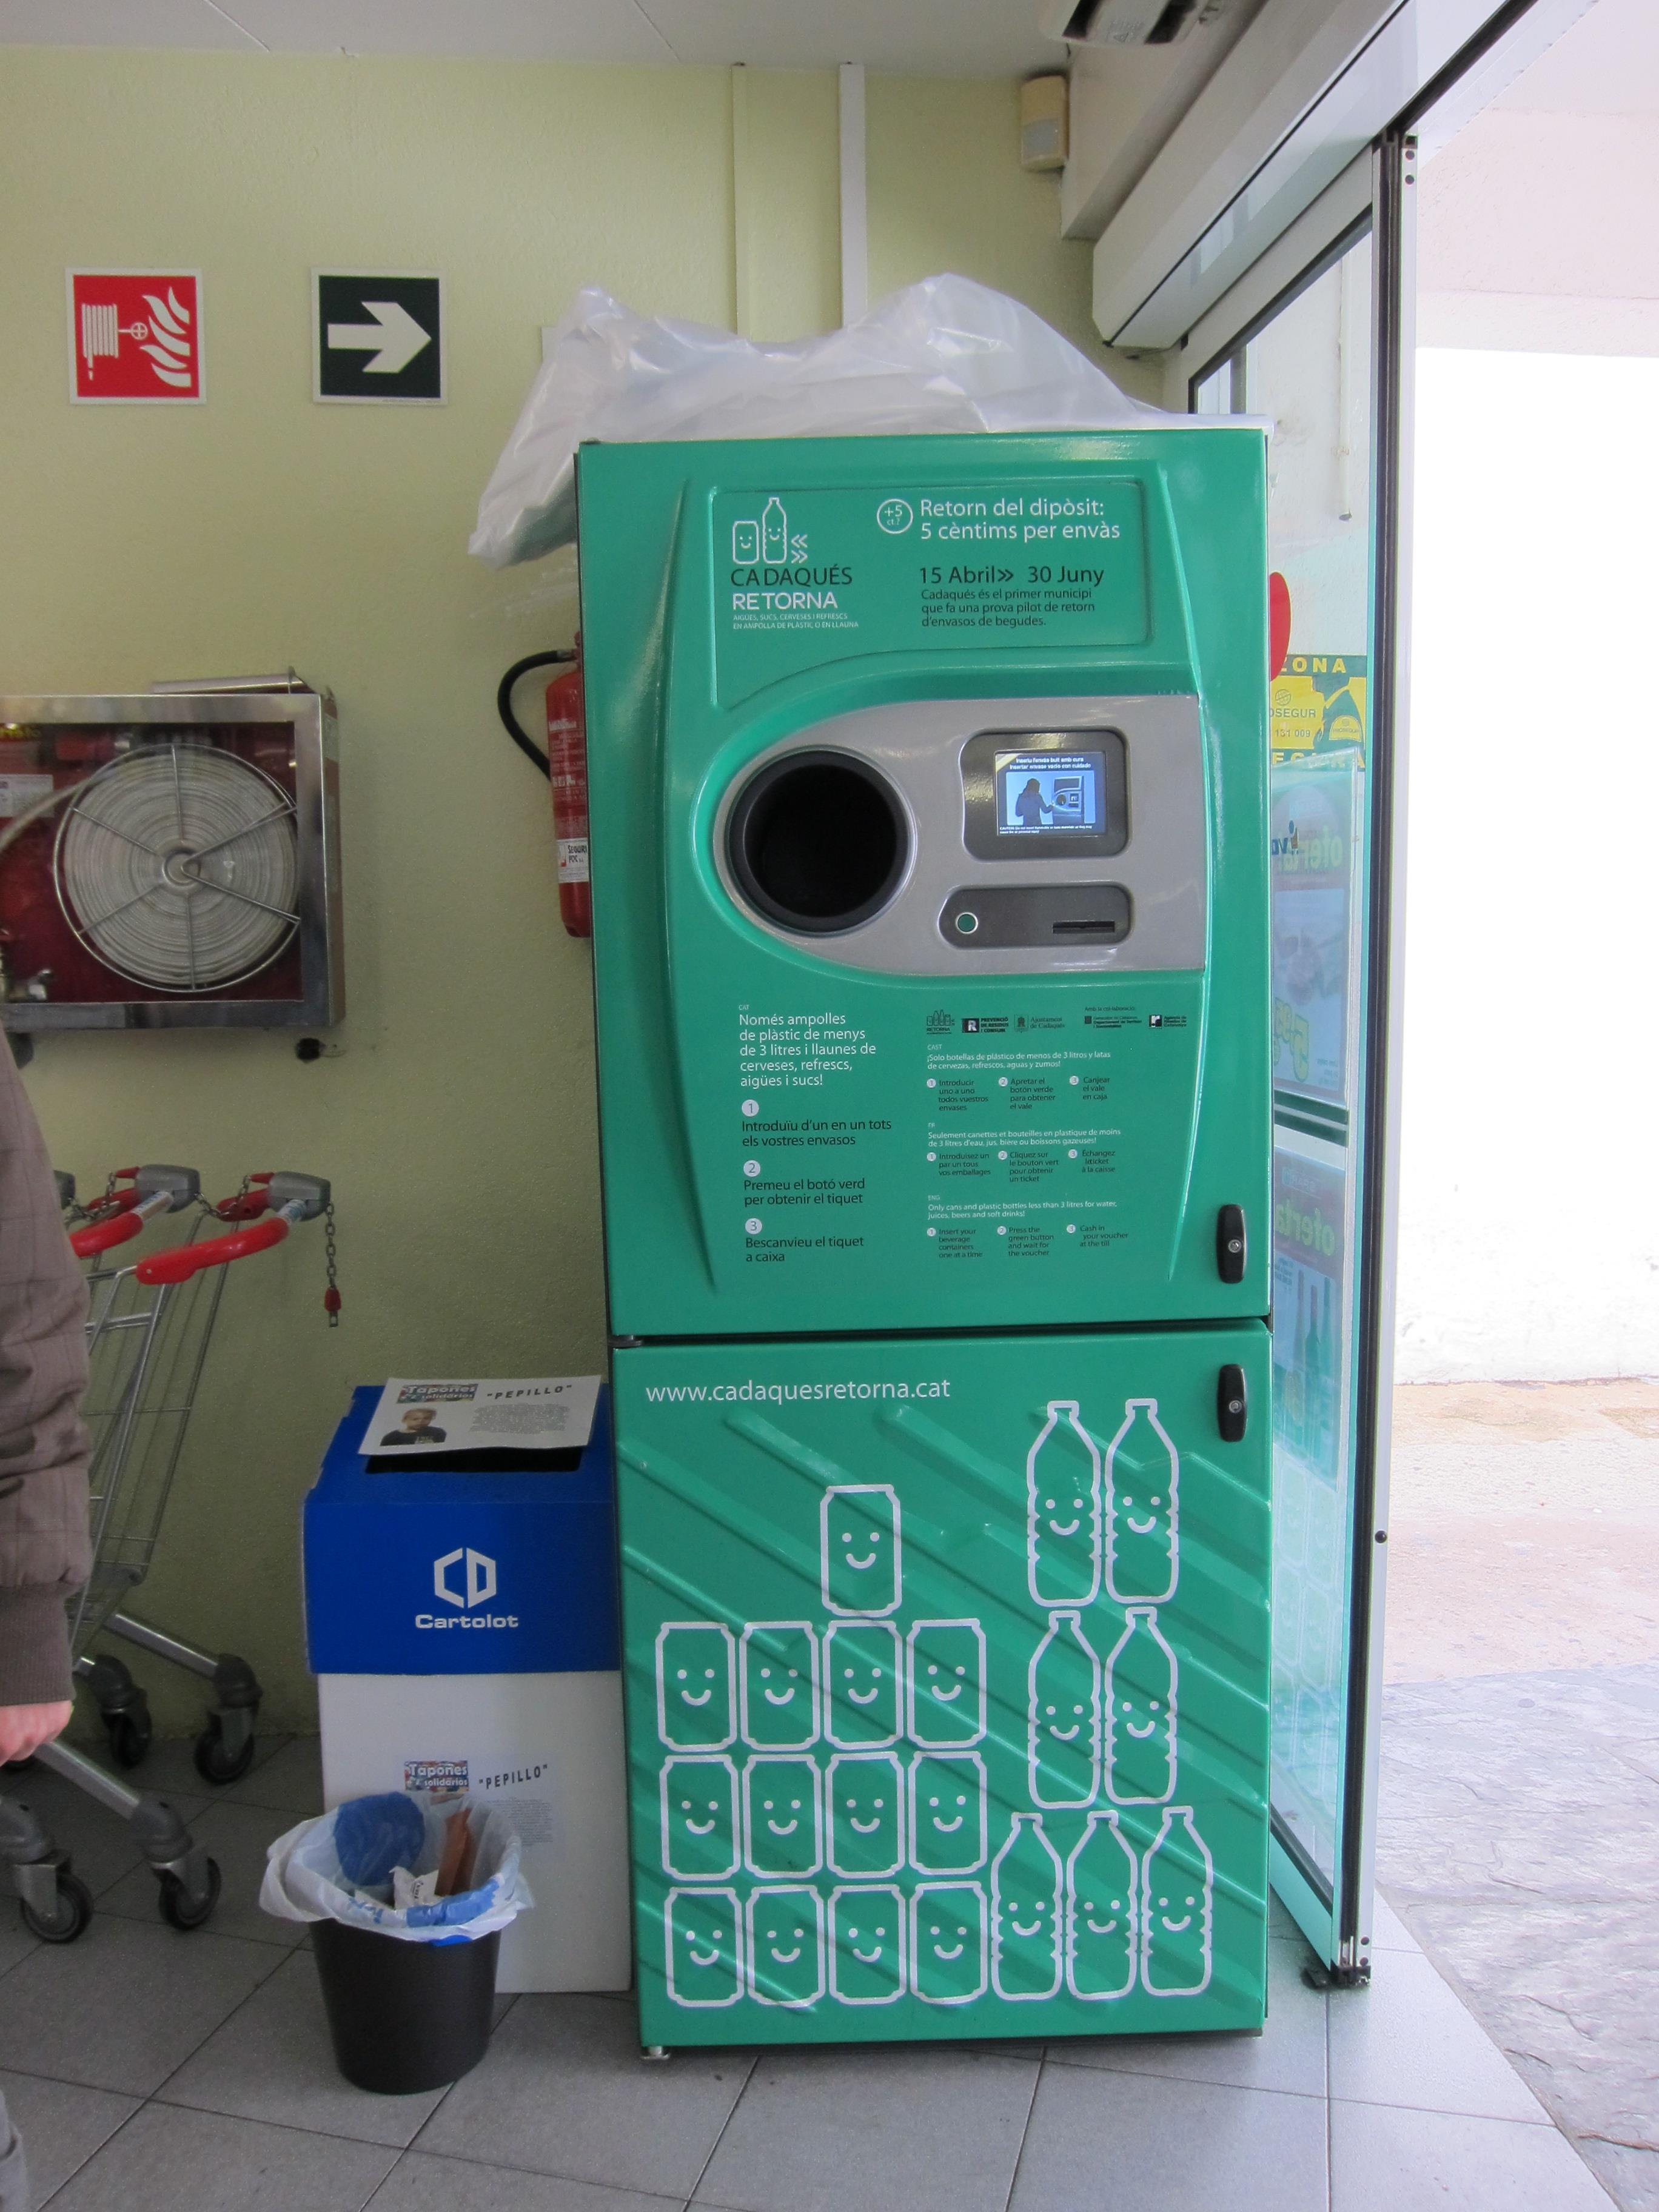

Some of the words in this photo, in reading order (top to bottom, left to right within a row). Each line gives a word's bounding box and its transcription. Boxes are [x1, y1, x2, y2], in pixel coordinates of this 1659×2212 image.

[884, 504, 902, 517] +5
[921, 499, 986, 517] Retorn
[993, 498, 1023, 515] del
[1030, 498, 1104, 520] dipòsit:
[921, 523, 931, 539] 5
[939, 522, 1017, 539] cèntims
[1024, 524, 1056, 543] per
[1062, 521, 1120, 538] envàs
[731, 564, 853, 587] CADAQUÉS
[920, 568, 942, 583] 15
[1028, 566, 1051, 583] 30
[1057, 566, 1104, 586] Juny
[733, 592, 838, 610] RETORNA
[921, 589, 975, 601] Cadaqués
[978, 589, 990, 598] és
[993, 588, 1002, 598] el
[1005, 589, 1041, 601] primer
[1044, 589, 1091, 600] municipi
[922, 605, 943, 615] que
[947, 602, 955, 613] fa
[982, 605, 1013, 615] prova
[1017, 602, 1041, 614] pilot
[1044, 602, 1058, 612] de
[1061, 603, 1094, 612] retorn
[922, 616, 975, 627] d'envasos
[978, 616, 992, 626] de
[995, 615, 1046, 628] begudes.
[1295, 729, 1310, 737] 009
[739, 1014, 784, 1025] Només
[788, 1013, 846, 1027] ampolles
[739, 1030, 755, 1041] de
[759, 1028, 800, 1042] plàstic
[803, 1028, 820, 1040] de
[823, 1030, 865, 1042] menys
[740, 1045, 756, 1056] de
[760, 1045, 766, 1056] 3
[771, 1044, 801, 1055] litres
[805, 1044, 807, 1055] i
[811, 1043, 856, 1055] llaunes
[860, 1042, 876, 1054] de
[740, 1061, 797, 1072] cerveses,
[801, 1059, 853, 1071] refrescs,
[740, 1074, 782, 1090] aigües
[786, 1074, 788, 1086] i
[793, 1074, 823, 1086] sucs!
[742, 1120, 798, 1132] Introduïu
[801, 1119, 828, 1131] d'un
[831, 1121, 846, 1130] en
[850, 1121, 865, 1130] un
[869, 1119, 891, 1130] tots
[742, 1136, 758, 1147] els
[762, 1136, 804, 1146] vostres
[807, 1136, 856, 1145] envasos
[744, 1180, 791, 1190] Premeu
[794, 1179, 803, 1190] el
[807, 1178, 836, 1190] botó
[839, 1178, 865, 1189] verd
[745, 1196, 764, 1207] per
[767, 1194, 811, 1205] obtenir
[814, 1193, 823, 1204] el
[828, 1193, 863, 1205] tiquet
[979, 1203, 1000, 1212] plastic
[746, 1237, 812, 1248] Bescanvieu
[815, 1236, 825, 1247] el
[829, 1236, 863, 1248] tiquet
[746, 1253, 752, 1262] a
[756, 1252, 785, 1262] caixa
[645, 1379, 951, 1405] www.cadaquesretorna.cat
[415, 1614, 519, 1629] Cartolot
[424, 1777, 468, 1789] solidarios
